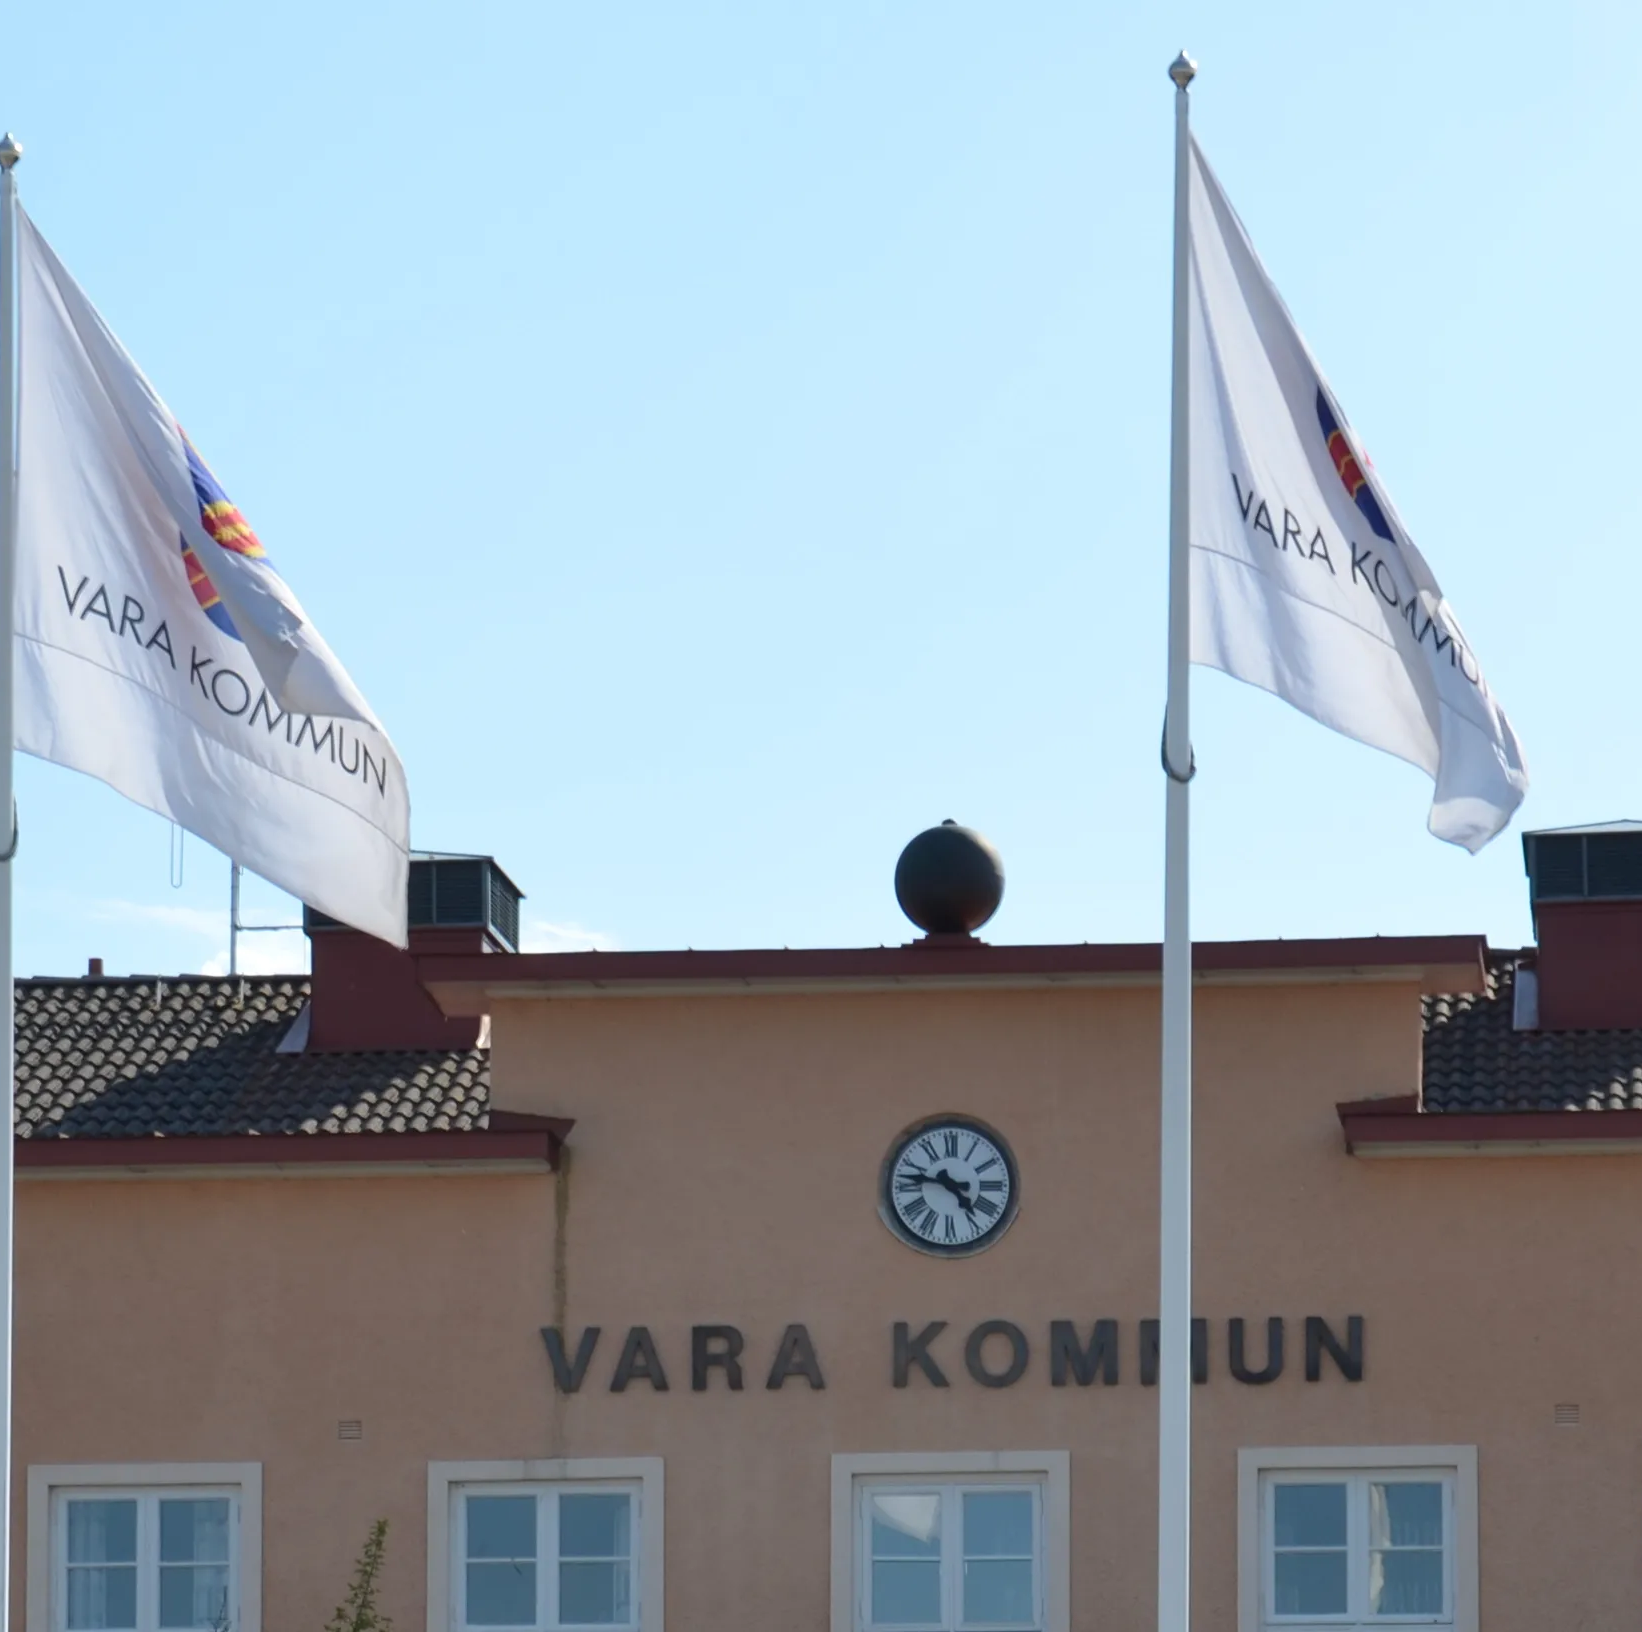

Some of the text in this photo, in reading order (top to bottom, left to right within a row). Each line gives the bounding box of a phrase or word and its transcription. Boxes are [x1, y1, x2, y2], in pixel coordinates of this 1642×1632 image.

[1231, 472, 1336, 576] VARA
[57, 565, 386, 799] VARA KOMMUN
[540, 1315, 1364, 1394] VARA KOMMUN
